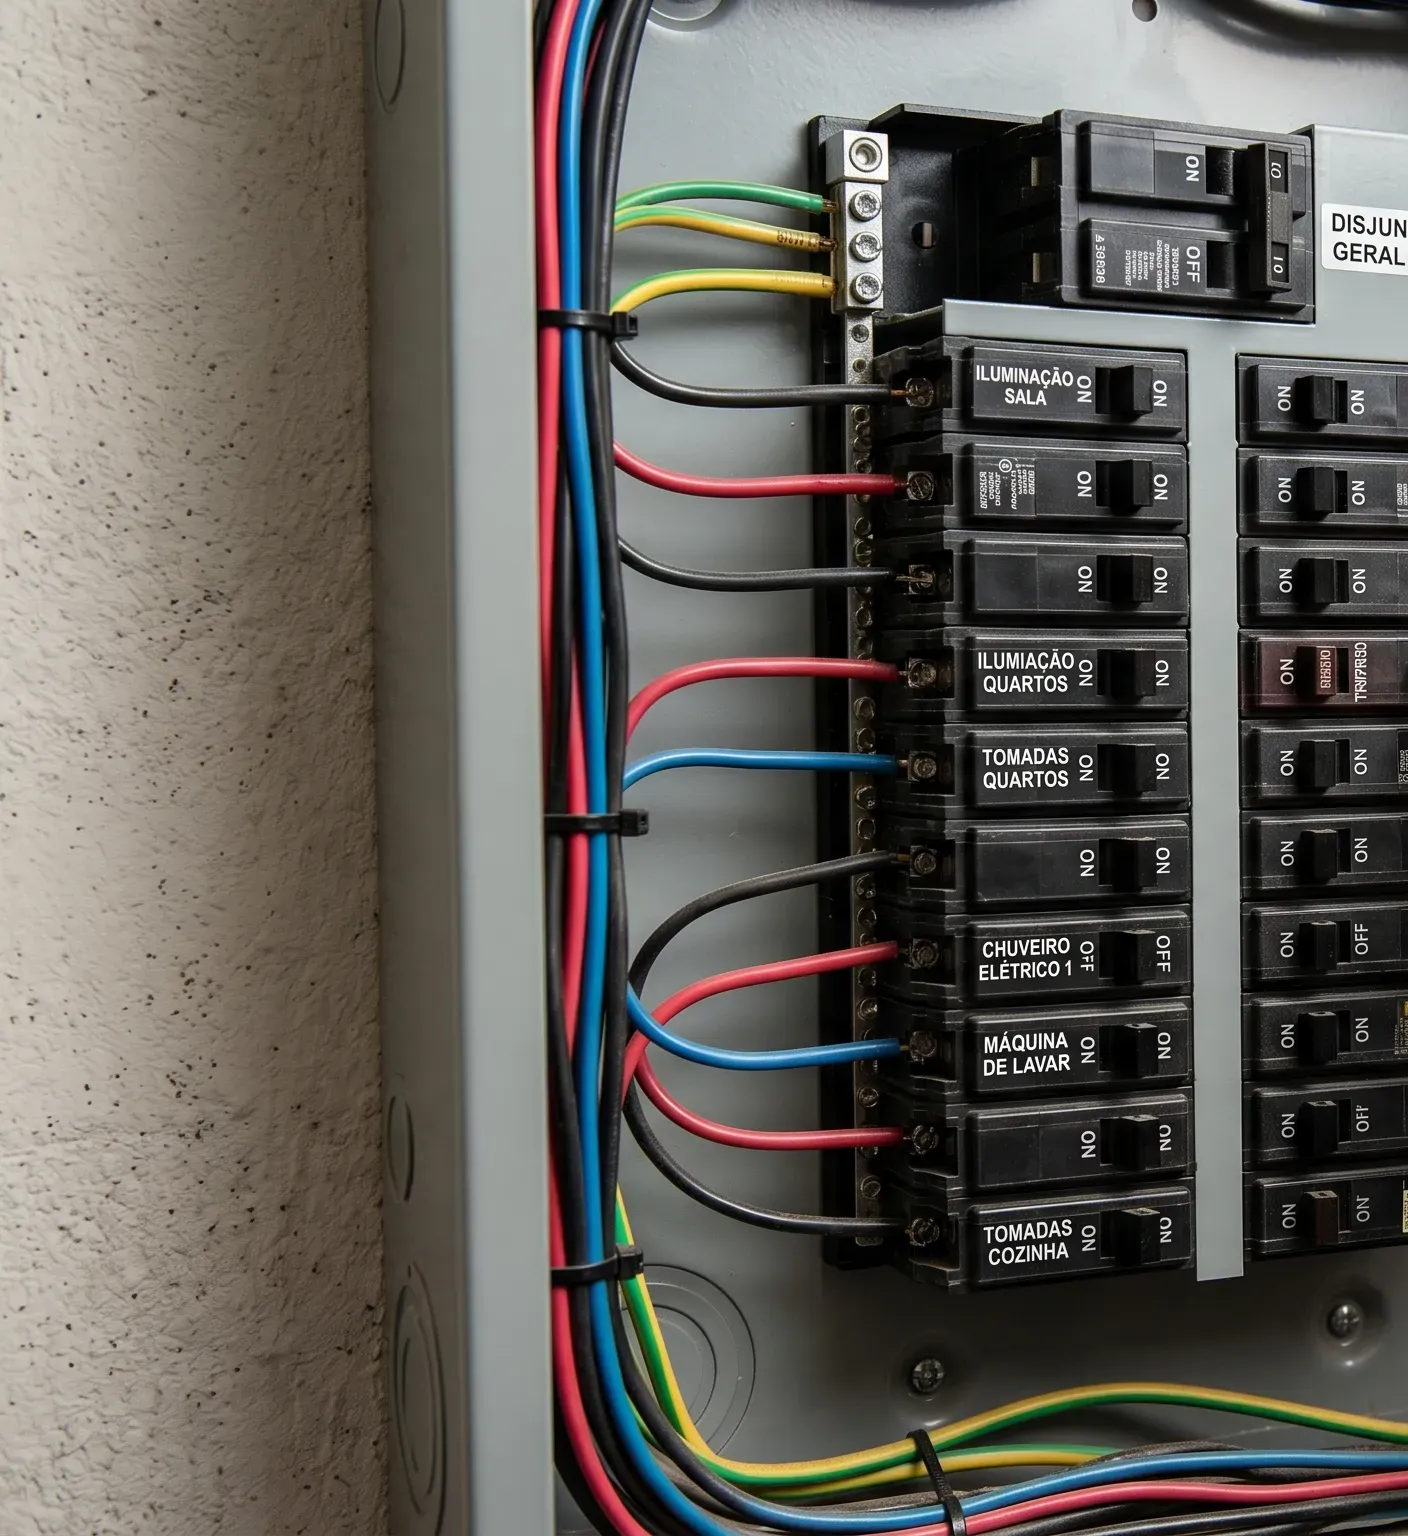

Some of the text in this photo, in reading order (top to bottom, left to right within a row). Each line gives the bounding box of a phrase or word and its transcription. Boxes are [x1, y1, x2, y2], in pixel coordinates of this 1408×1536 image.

[1185, 155, 1200, 182] ON
[1187, 246, 1200, 282] OFF
[1334, 243, 1406, 266] GERAL
[977, 365, 1073, 388] ILUMINAÇÃO
[1077, 376, 1091, 402] ON
[1005, 388, 1047, 406] SALA
[1153, 380, 1167, 406] ON
[1278, 386, 1291, 411] ON
[1351, 390, 1364, 414] ON
[1078, 471, 1092, 497] ON
[1154, 474, 1168, 499] ON
[1278, 478, 1291, 502] ON
[1352, 481, 1365, 505] ON
[1078, 566, 1092, 592] ON
[1154, 568, 1167, 593] ON
[1279, 569, 1292, 592] ON
[1352, 569, 1365, 593] ON
[979, 649, 1074, 673] ILUMIAÇÃO
[1079, 660, 1093, 685] ON
[1156, 660, 1169, 685] ON
[1280, 659, 1293, 684] ON
[984, 676, 1067, 693] QUARTOS
[982, 747, 1068, 765] TOMADAS
[1079, 755, 1093, 781] ON
[1156, 754, 1169, 779] ON
[1280, 751, 1293, 776] ON
[1354, 750, 1367, 774] ON
[984, 770, 1068, 789] QUARTOS
[1156, 848, 1170, 873] ON
[1281, 841, 1294, 866] ON
[1355, 838, 1367, 862] ON
[1080, 850, 1094, 876] ON
[983, 938, 1070, 958] CHUVEIRO
[1281, 932, 1293, 957] ON
[1355, 924, 1368, 954] OFF
[1157, 936, 1170, 972] OFF
[980, 957, 1071, 980] ELÉTRICO 1
[984, 1031, 1068, 1053] MÁQUINA
[1281, 1025, 1294, 1048] ON
[1356, 1018, 1368, 1042] ON
[1081, 1037, 1095, 1063] ON
[1158, 1033, 1171, 1059] ON
[984, 1054, 1070, 1076] DE LAVAR
[1160, 1125, 1171, 1151] ON
[1282, 1114, 1294, 1138] ON
[1081, 1131, 1095, 1158] ON
[1282, 1204, 1296, 1228] ON
[1357, 1196, 1370, 1222] ON
[984, 1219, 1072, 1243] TOMADAS
[1082, 1225, 1096, 1251] ON
[1160, 1217, 1171, 1243] ON
[988, 1242, 1069, 1265] COZINHA
